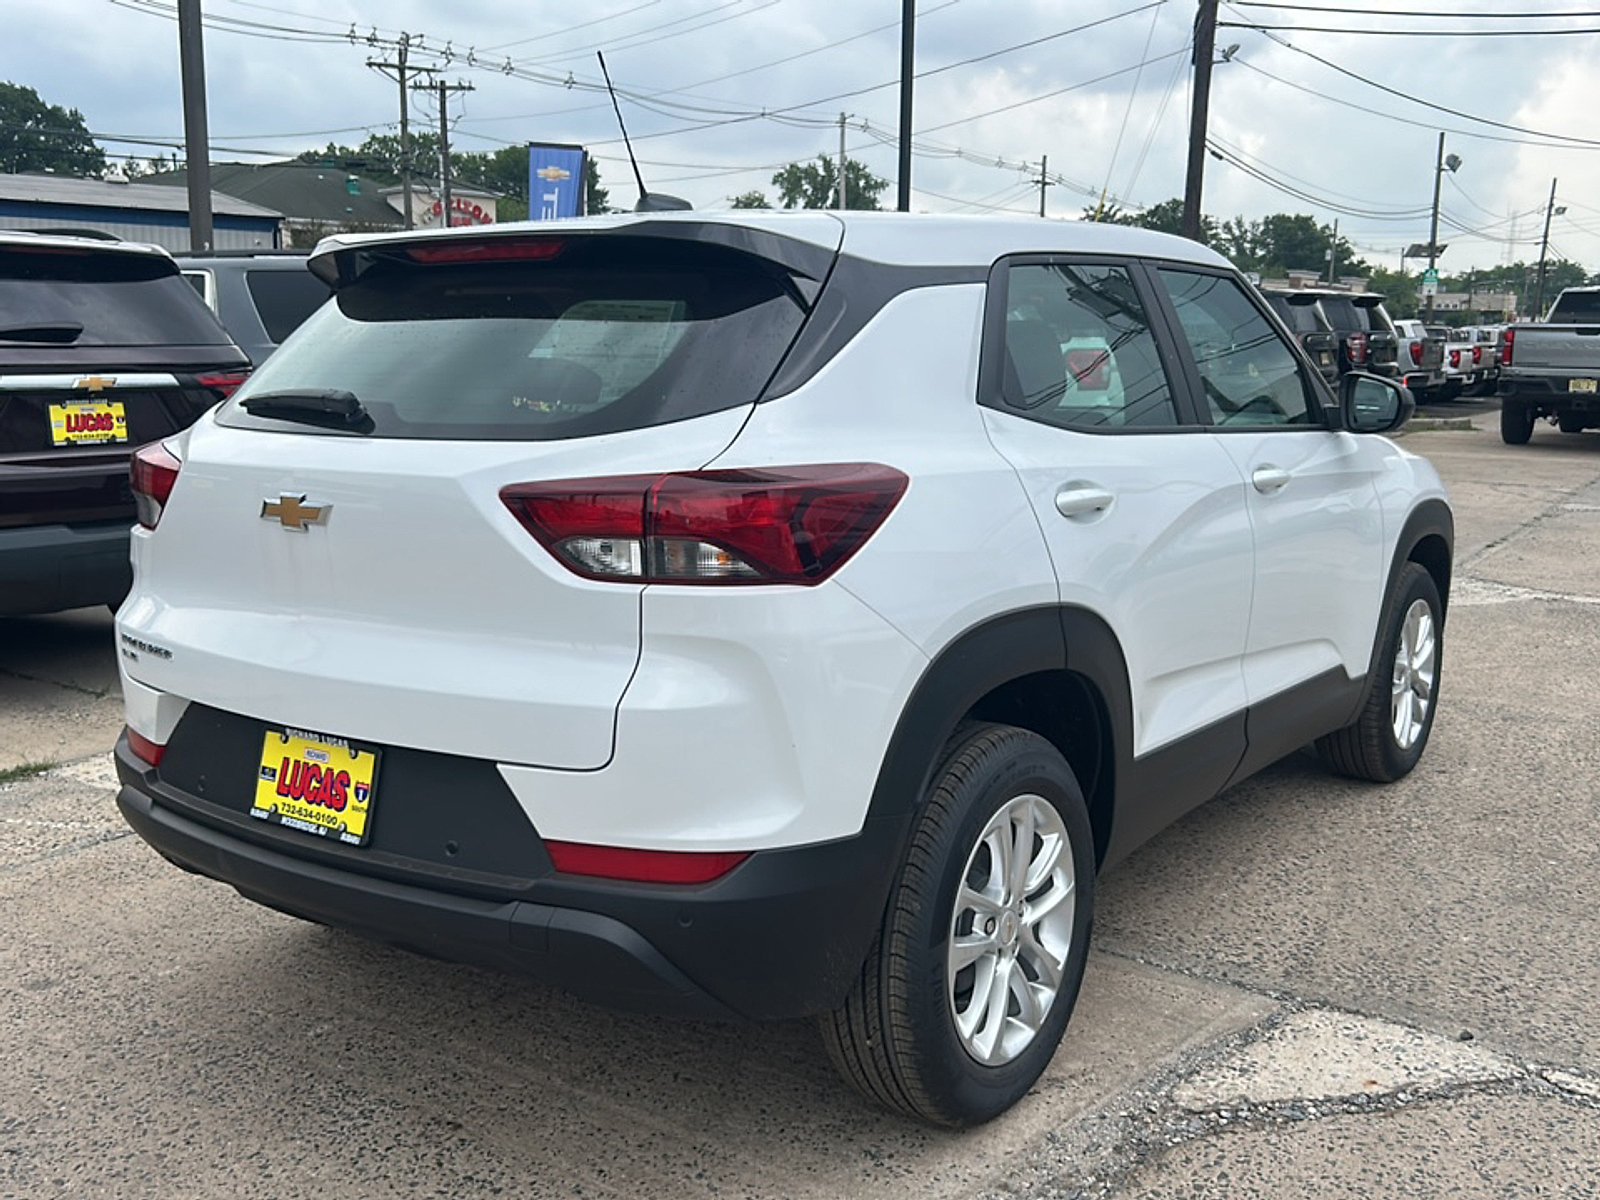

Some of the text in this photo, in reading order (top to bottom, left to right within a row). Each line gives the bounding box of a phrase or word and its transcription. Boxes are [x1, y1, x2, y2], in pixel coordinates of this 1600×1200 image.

[423, 198, 493, 225] OIZON
[66, 412, 114, 433] LUCAS
[277, 757, 351, 812] LUCAS
[281, 802, 338, 825] 732-634-0100
